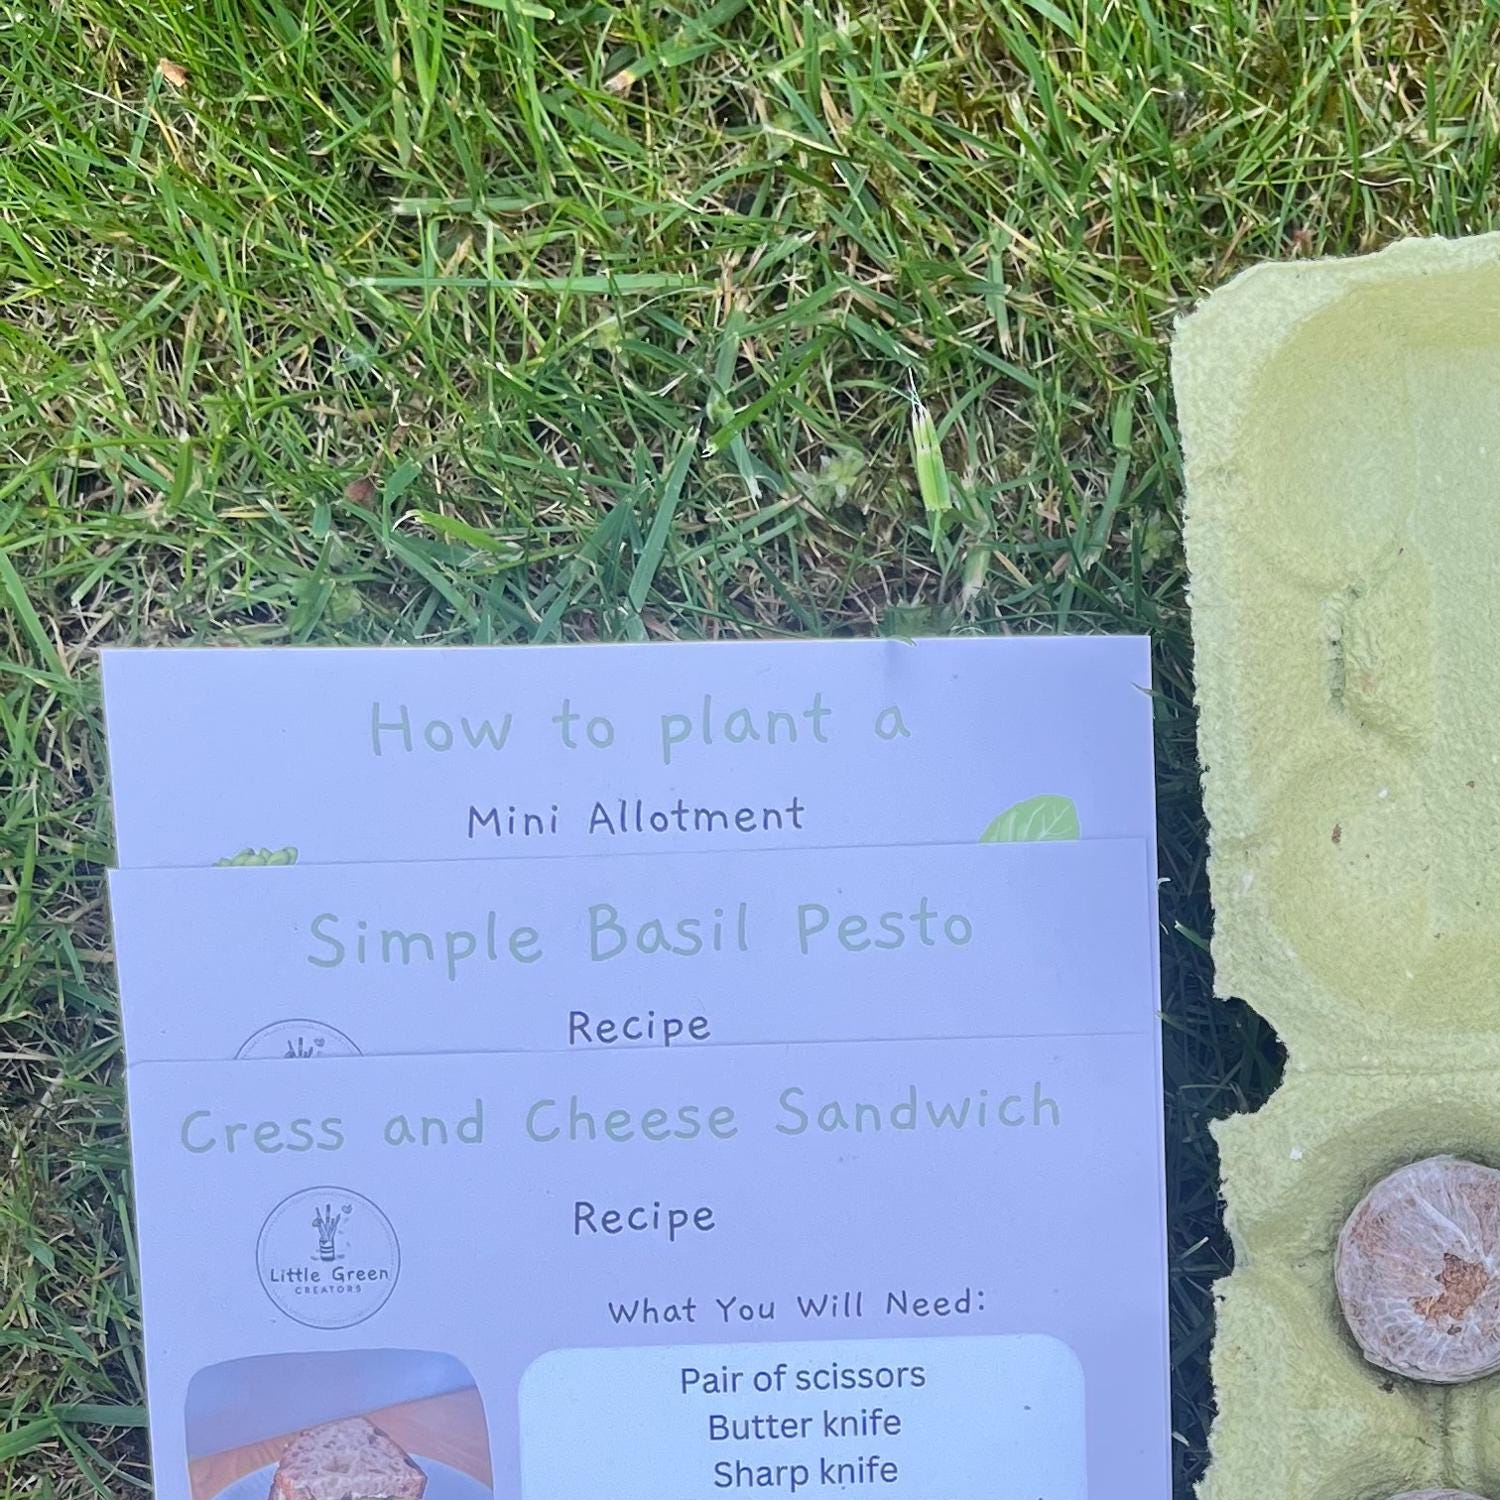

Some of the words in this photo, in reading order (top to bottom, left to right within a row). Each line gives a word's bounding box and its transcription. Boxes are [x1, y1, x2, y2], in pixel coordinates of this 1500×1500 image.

[372, 702, 512, 756] How
[552, 699, 614, 749] to
[661, 693, 831, 765] plant
[875, 705, 911, 740] a
[469, 805, 557, 838] Mini
[590, 797, 804, 834] Allotment
[307, 911, 542, 981] Simple
[588, 902, 748, 961] Basil
[797, 897, 972, 954] Pesto
[570, 1011, 710, 1047] Recipe
[181, 1111, 344, 1153] Cress
[384, 1098, 483, 1146] and
[526, 1095, 738, 1142] Cheese
[776, 1082, 1059, 1135] Sandwich
[575, 1202, 715, 1241] Recipe
[271, 1268, 320, 1282] Little
[332, 1266, 388, 1282] Green
[295, 1285, 361, 1294] CREATORS
[609, 1298, 696, 1323] What
[716, 1296, 774, 1322] You
[797, 1292, 861, 1317] Will
[887, 1288, 983, 1316] Need:
[682, 1366, 743, 1394] Pair
[754, 1364, 787, 1391] of
[796, 1362, 925, 1390] scissors
[710, 1415, 813, 1440] Butter
[824, 1408, 900, 1437] knife
[715, 1460, 808, 1492] Sharp
[821, 1456, 897, 1484] knife
